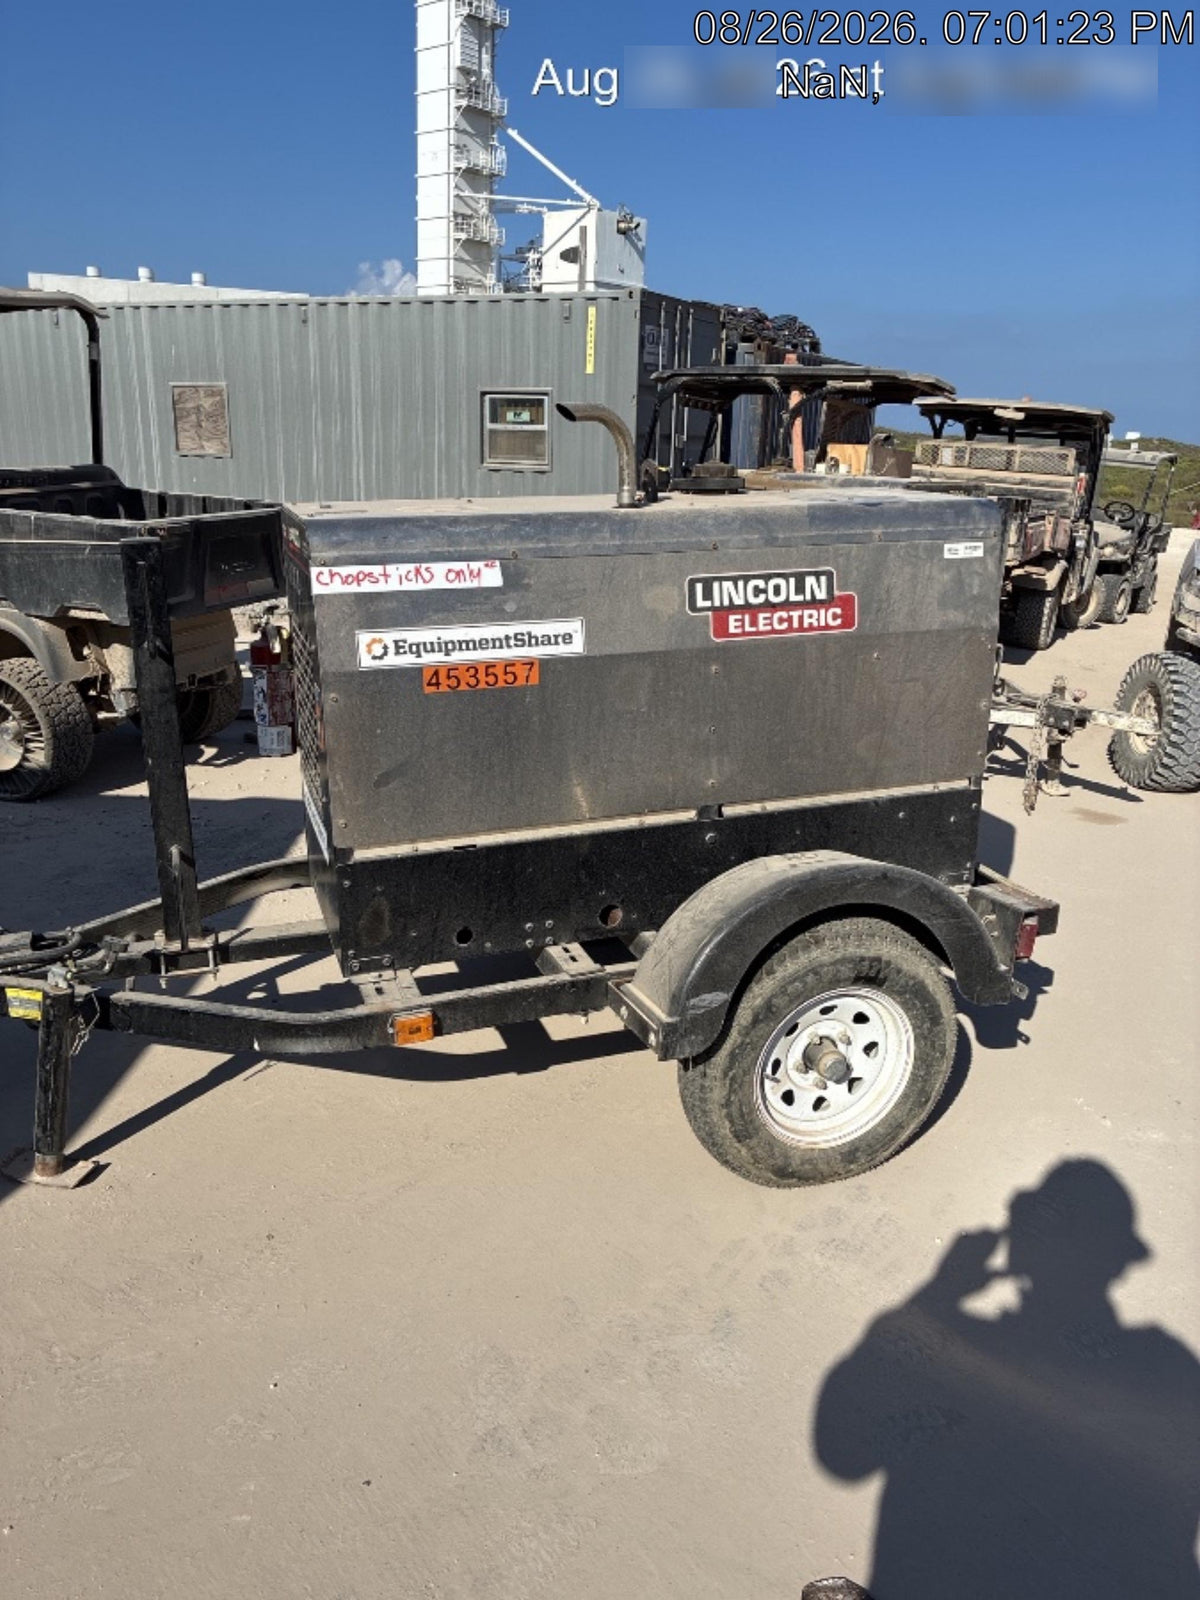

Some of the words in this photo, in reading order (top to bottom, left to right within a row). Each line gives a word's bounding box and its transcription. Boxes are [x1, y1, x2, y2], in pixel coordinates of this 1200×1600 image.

[695, 575, 828, 608] LINCOLN
[728, 607, 842, 634] ELECTRIC
[392, 630, 573, 658] EquipmentShare
[426, 662, 535, 691] 453557
